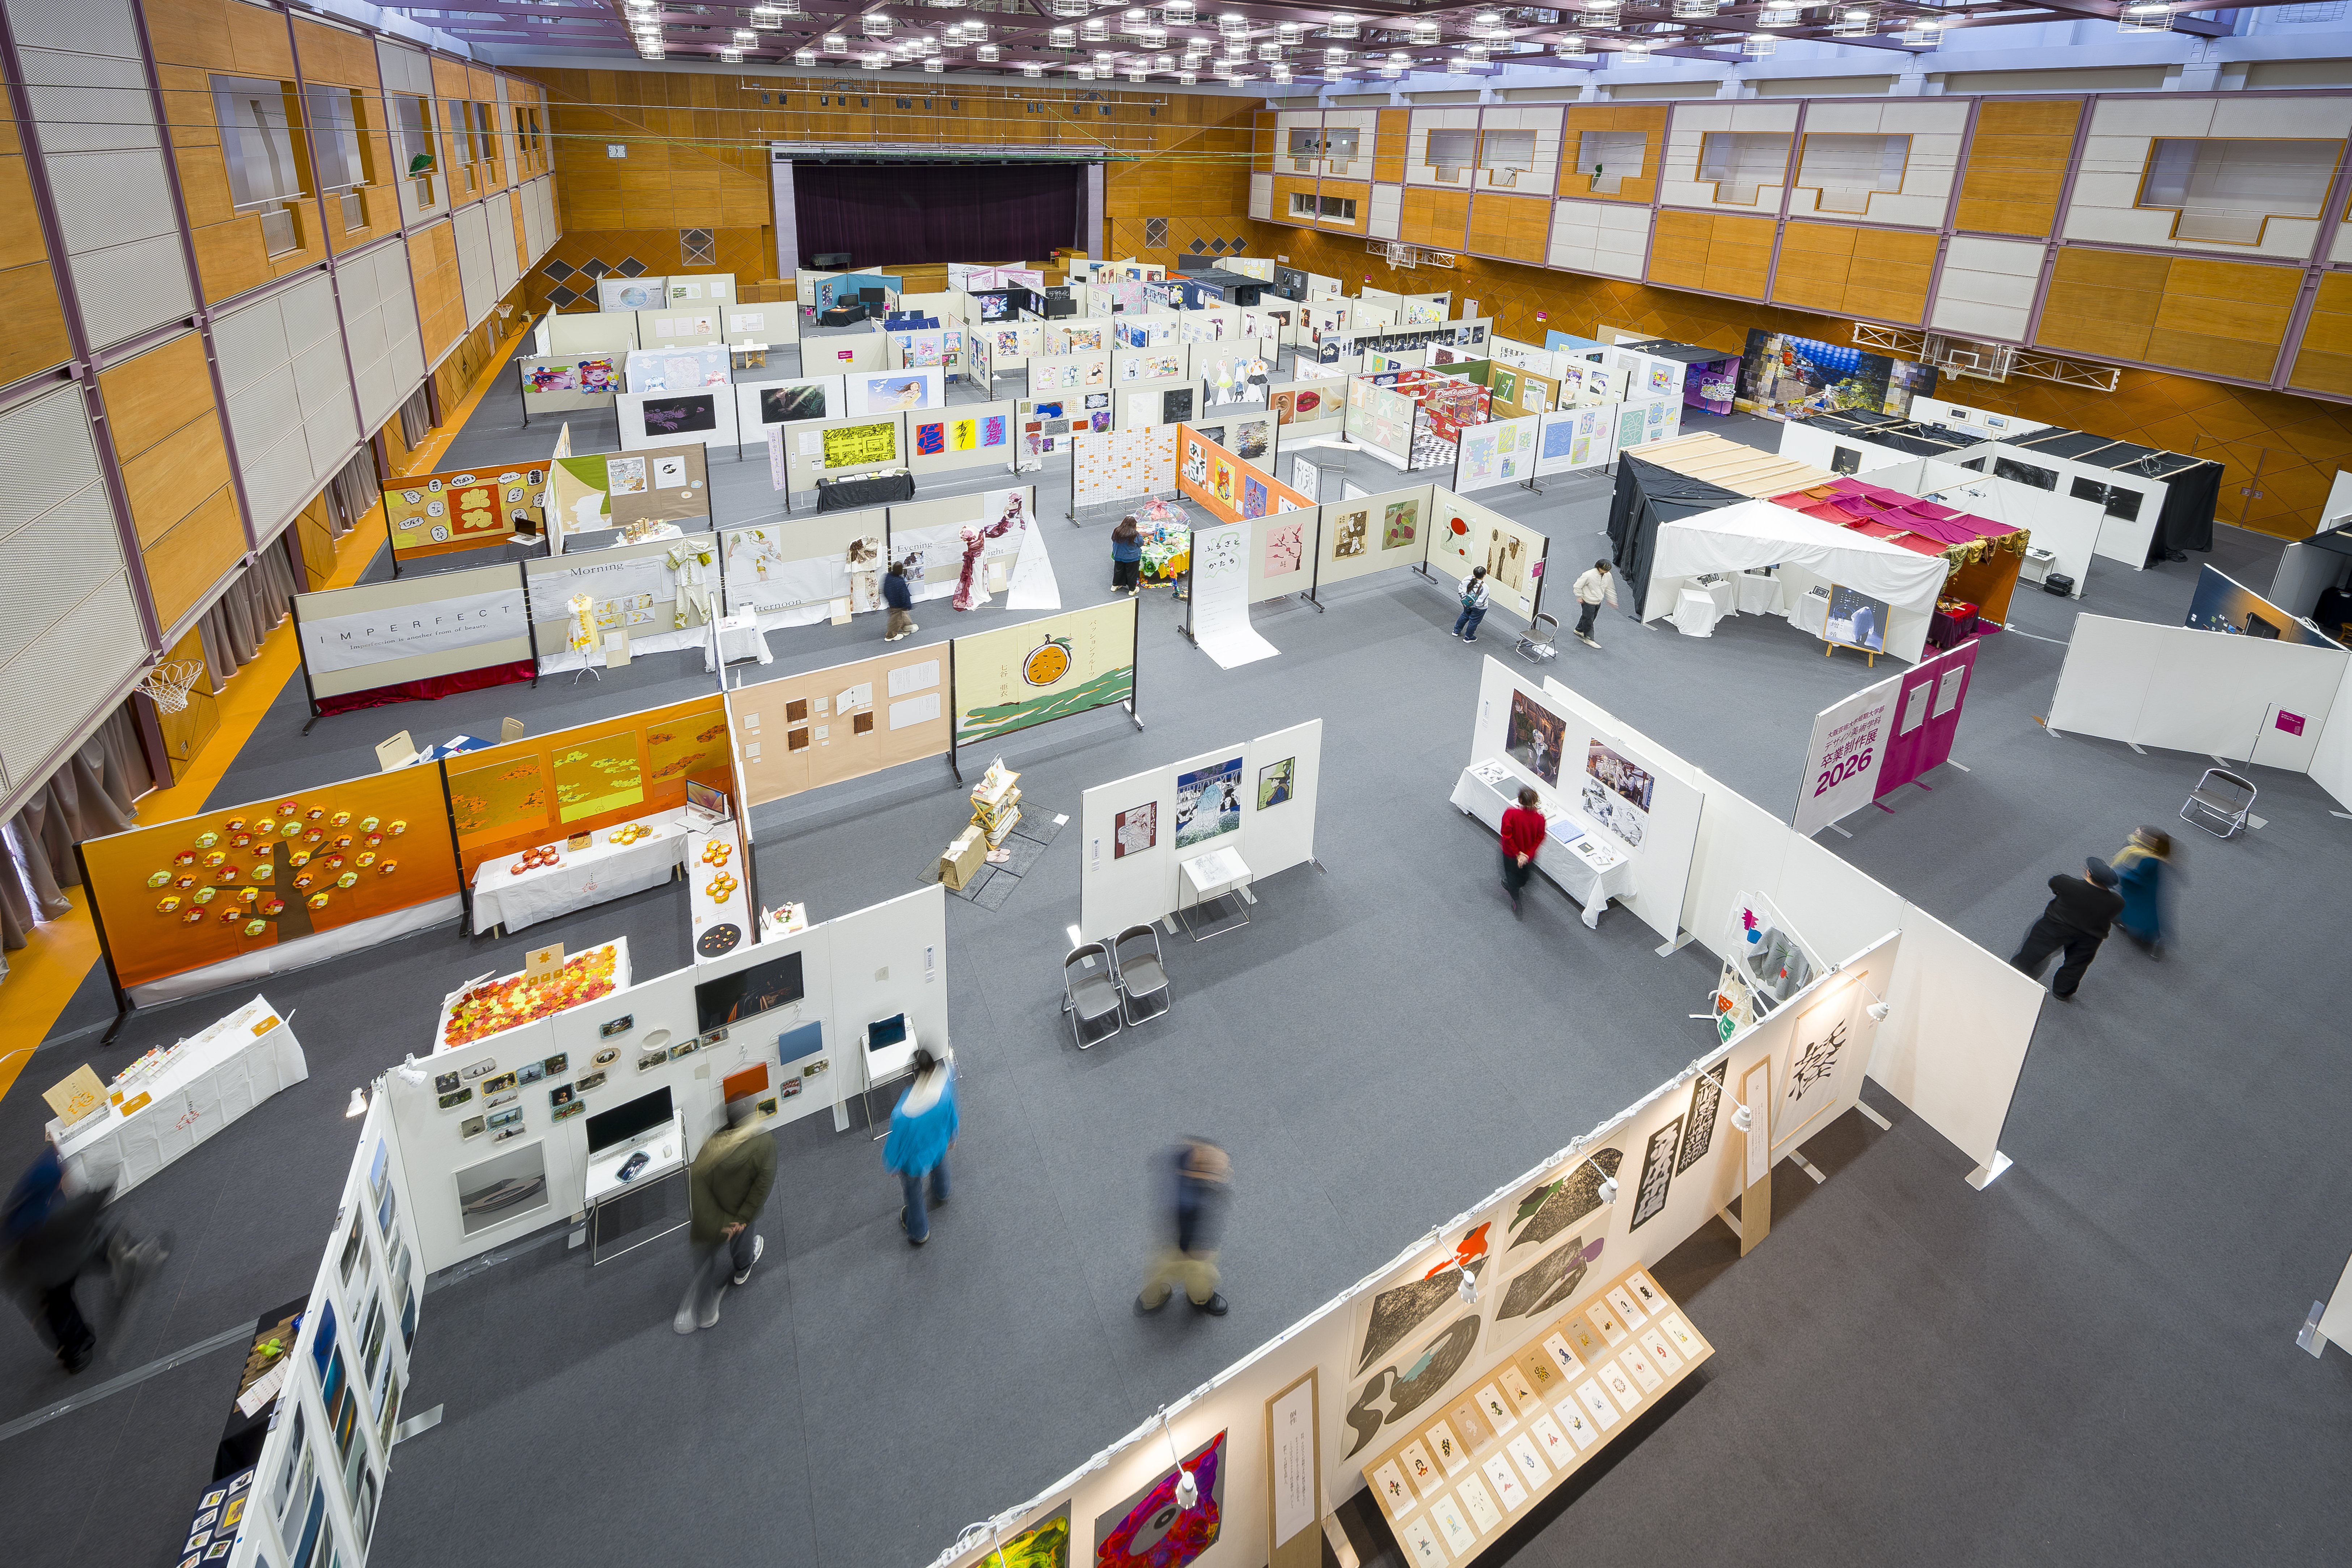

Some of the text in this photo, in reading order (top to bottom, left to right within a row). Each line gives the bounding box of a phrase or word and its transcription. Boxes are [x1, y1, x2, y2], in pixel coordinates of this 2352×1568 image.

[1435, 387, 1479, 399] Diner's cosmic
[897, 542, 933, 553] Evening
[988, 548, 1004, 557] ight
[1205, 540, 1240, 552] ふるさと
[570, 563, 624, 577] Morning
[1209, 558, 1235, 570] かたち
[754, 599, 801, 613] fternoon
[321, 606, 509, 643] IMPERFECT
[350, 638, 395, 650] Imperfection
[999, 665, 1008, 698] 七谷 亜衣
[1827, 705, 1885, 740] 大阪芸術大学短期大学部
[1825, 715, 1882, 752] デザイン美術学科
[1820, 728, 1878, 769] 卒業制作展
[1813, 747, 1873, 799] 2026
